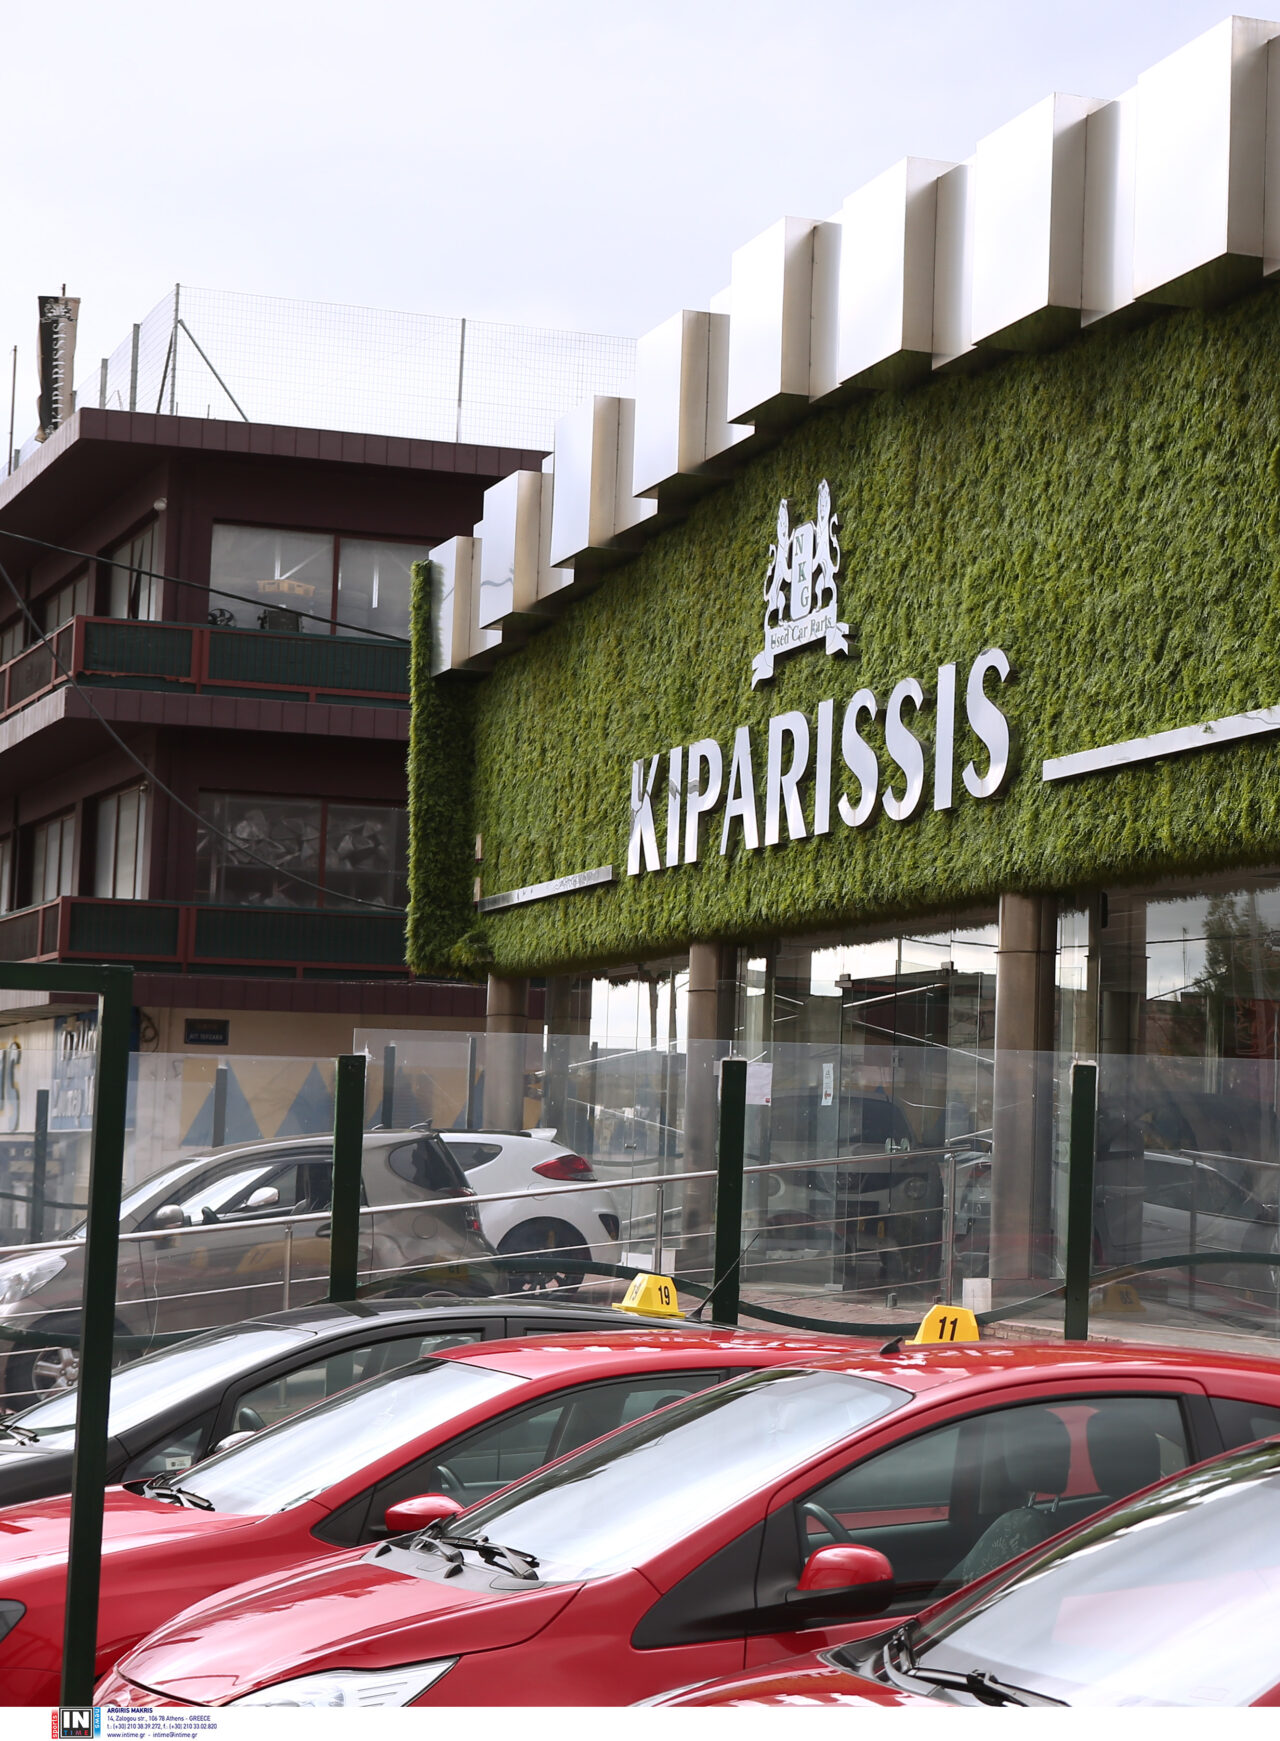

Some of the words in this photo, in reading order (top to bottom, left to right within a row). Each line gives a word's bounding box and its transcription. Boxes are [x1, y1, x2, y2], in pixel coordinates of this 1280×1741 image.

[770, 630, 789, 650] Used
[792, 624, 809, 642] Car
[810, 614, 832, 636] Parts
[627, 648, 1011, 876] KIPARISSIS
[658, 1285, 670, 1306] 19
[939, 1316, 958, 1341] 11
